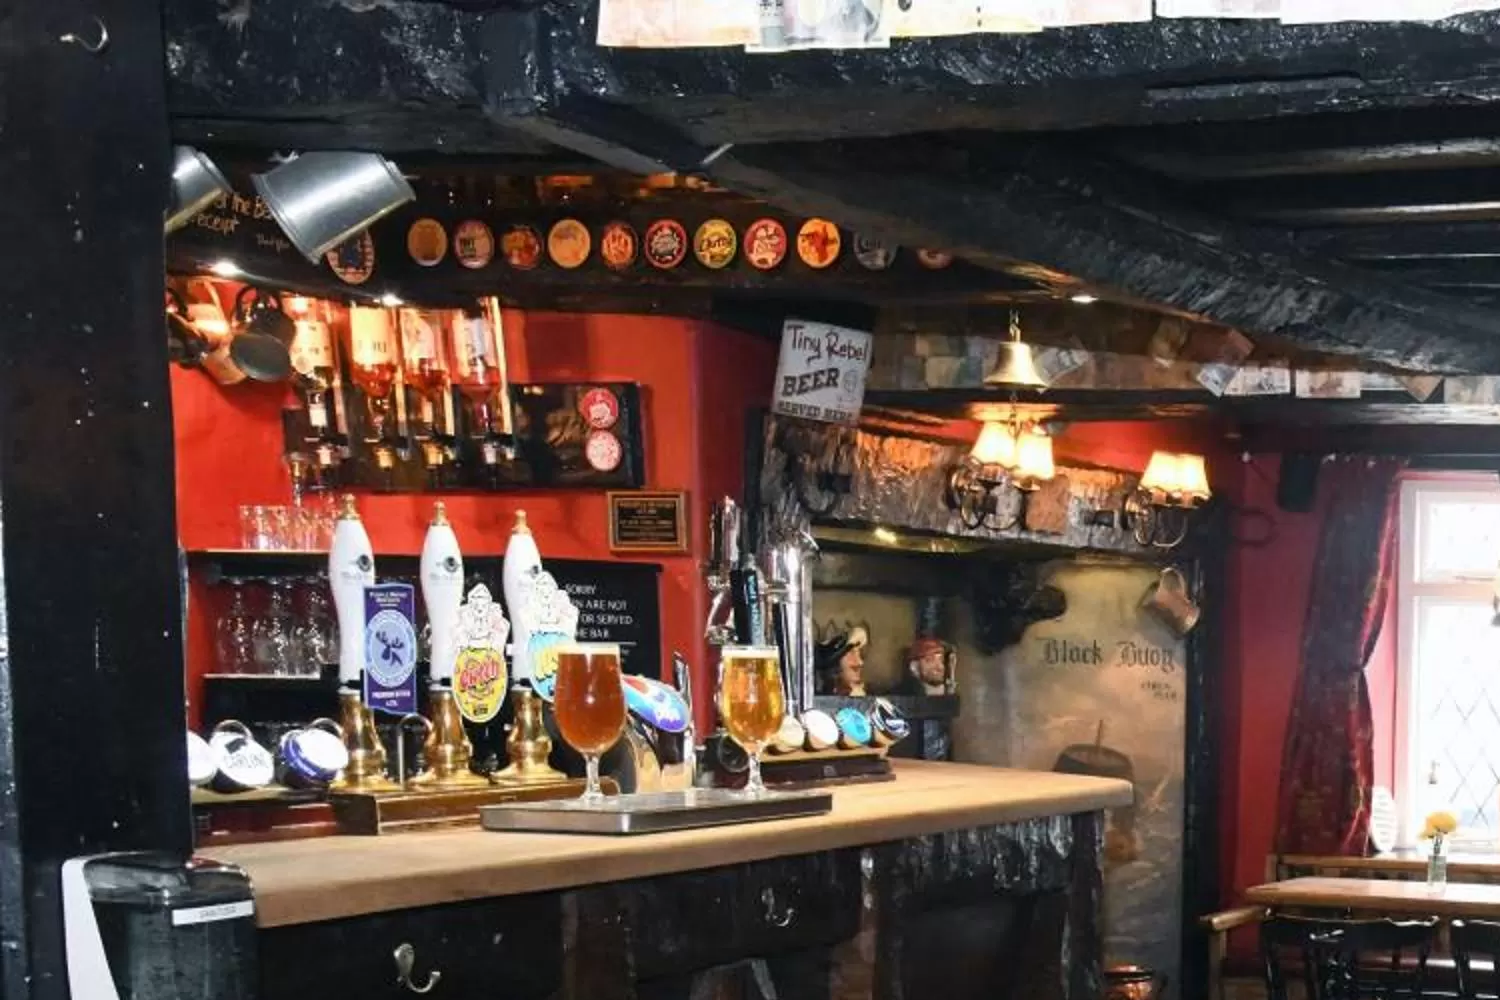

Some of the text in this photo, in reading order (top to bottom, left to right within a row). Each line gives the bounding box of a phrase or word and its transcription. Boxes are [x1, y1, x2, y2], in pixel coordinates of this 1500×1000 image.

[787, 324, 869, 366] Tiny Rebel
[782, 368, 839, 396] BEER
[566, 584, 596, 594] SORRY
[586, 600, 606, 610] ARE
[607, 600, 627, 610] NOT
[596, 614, 633, 625] SERVED
[589, 629, 609, 639] BAR
[1035, 638, 1102, 665] Black
